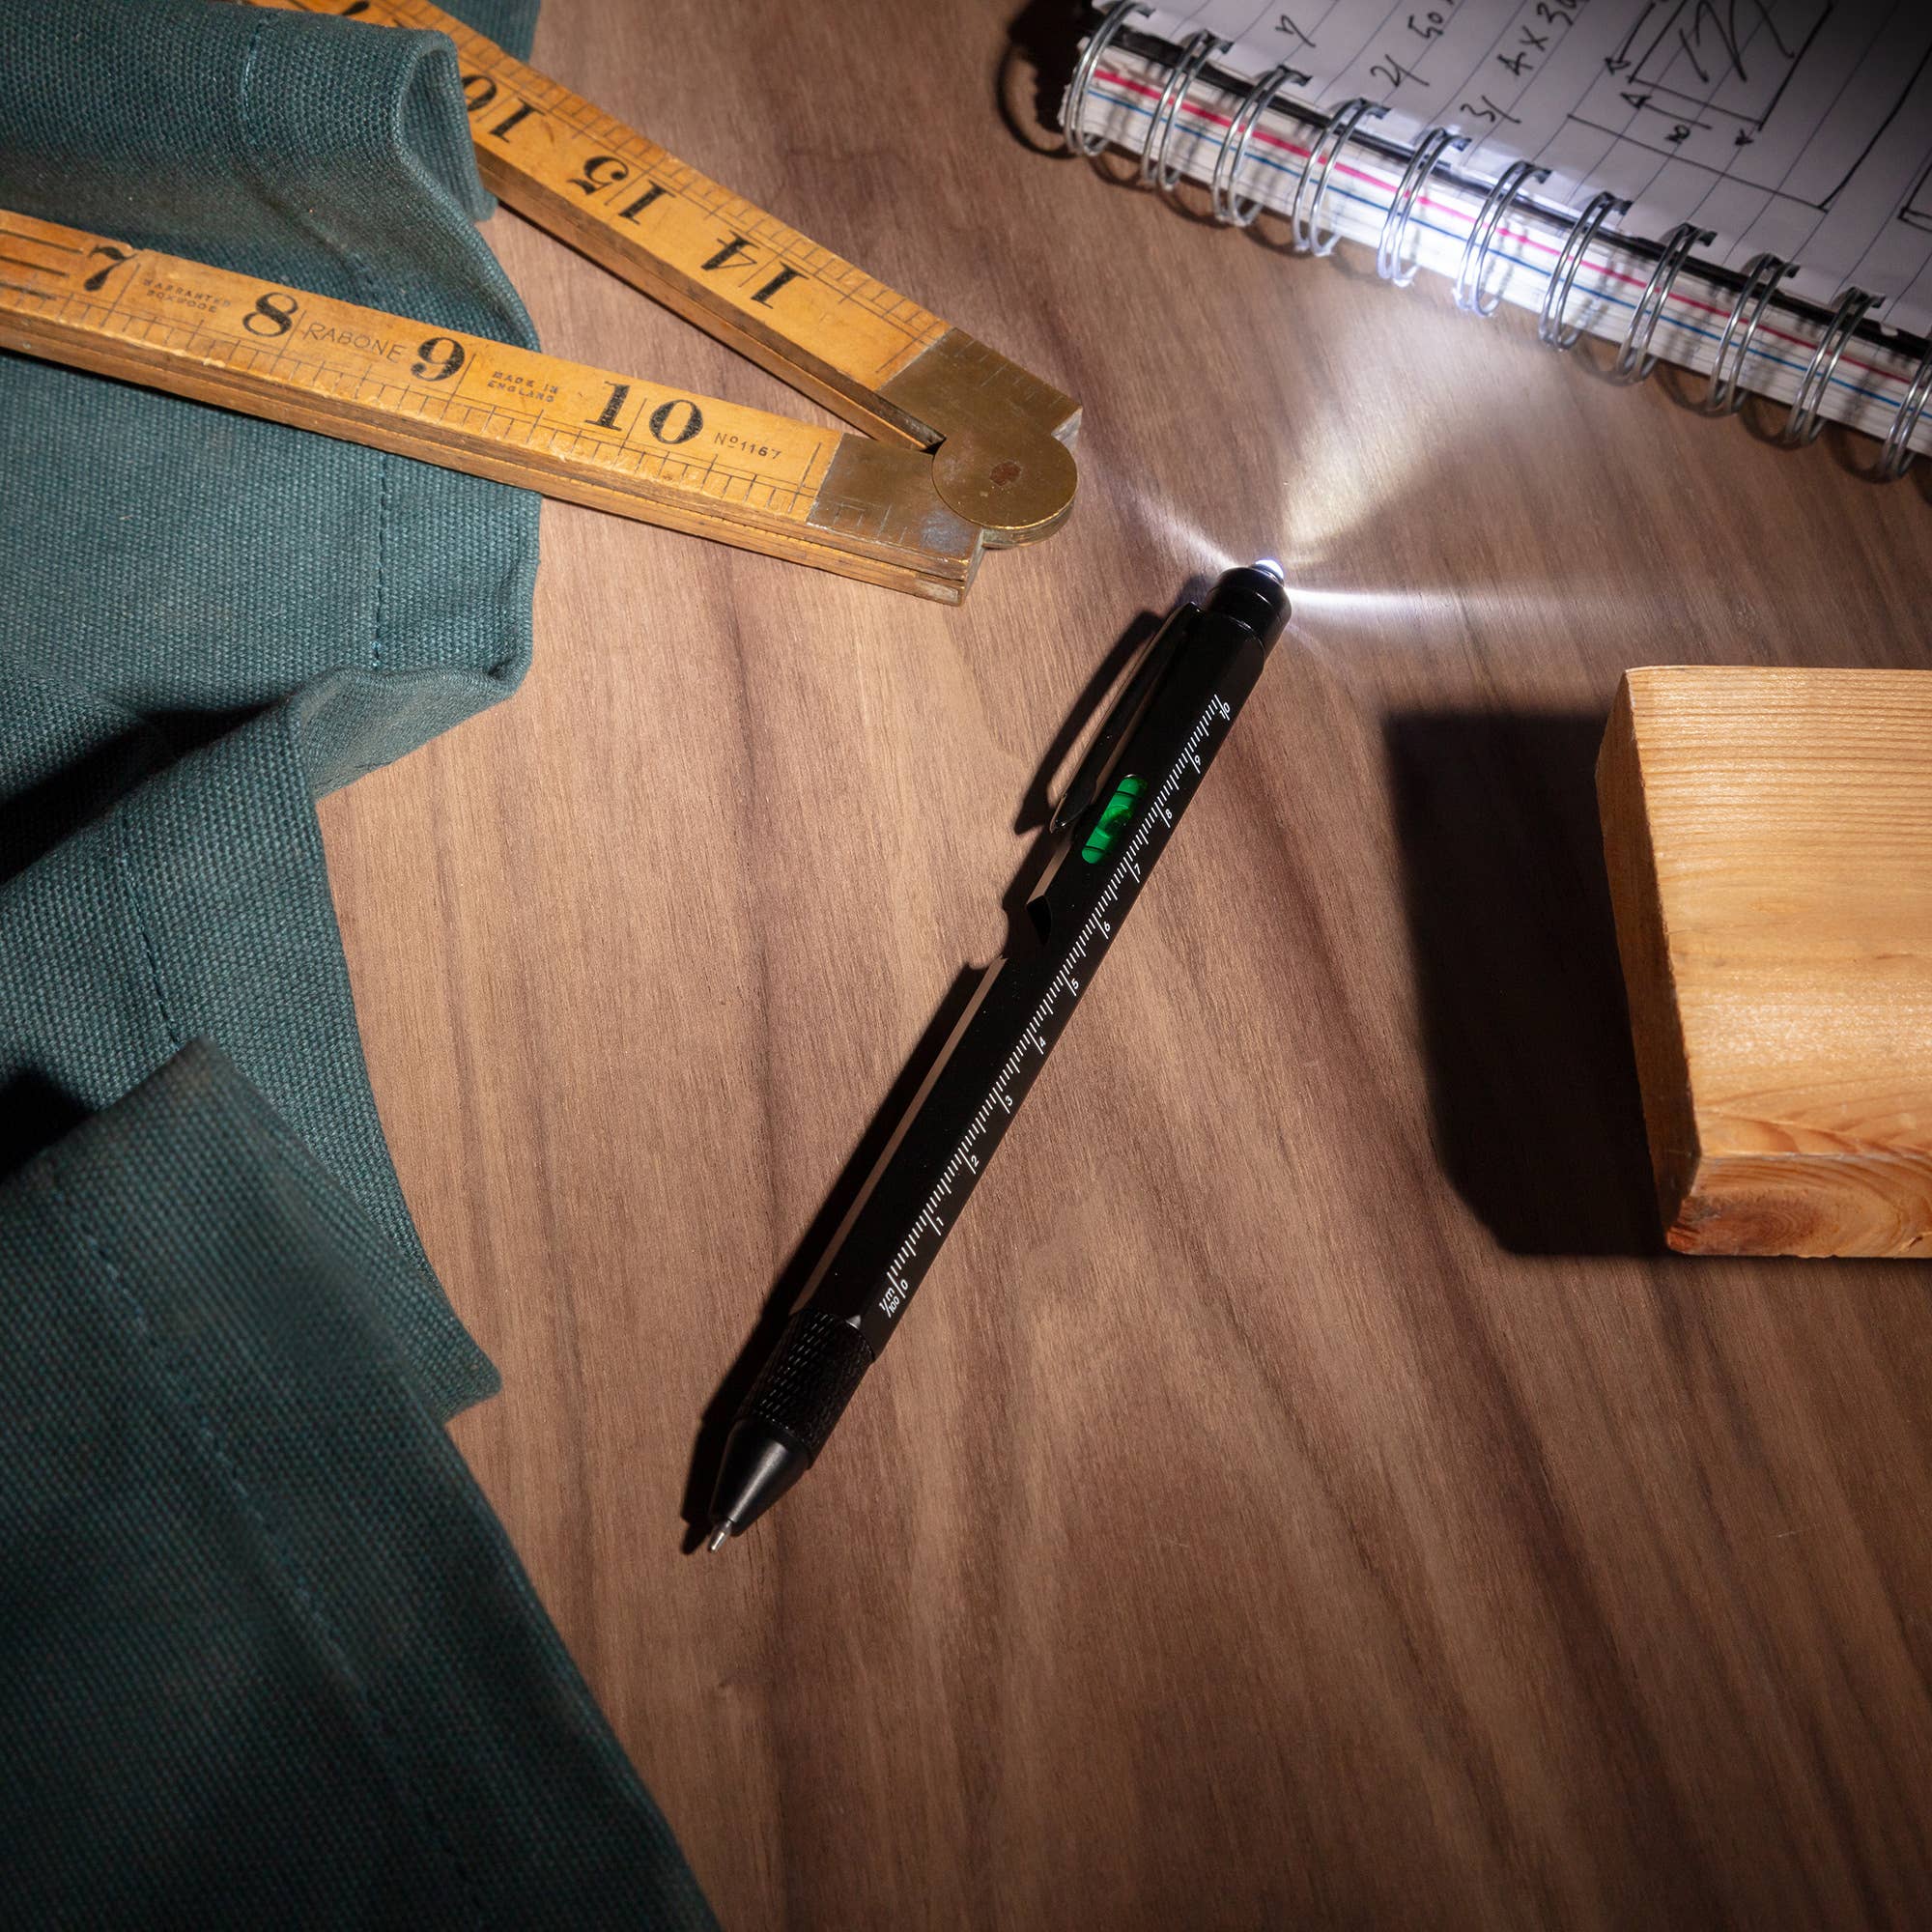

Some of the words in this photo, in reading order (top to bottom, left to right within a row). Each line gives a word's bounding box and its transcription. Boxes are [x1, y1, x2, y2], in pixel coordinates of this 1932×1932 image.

[566, 156, 676, 225] 15
[84, 243, 138, 292] 7
[700, 230, 810, 309] 14
[242, 292, 298, 338] 8
[302, 322, 407, 364] RABONE
[411, 336, 466, 383] 9
[487, 380, 554, 403] ENGLAND
[492, 371, 534, 387] MADE
[544, 384, 558, 394] IN
[584, 381, 704, 444] 10
[900, 1279, 909, 1291] 0
[971, 1154, 980, 1167] 2
[1005, 1094, 1013, 1107] 3
[1039, 1036, 1046, 1048] 4
[1071, 978, 1079, 990] 5
[1103, 921, 1111, 932] 6
[1133, 863, 1141, 875] 7
[1165, 808, 1173, 820] 8
[1194, 754, 1202, 766] 9
